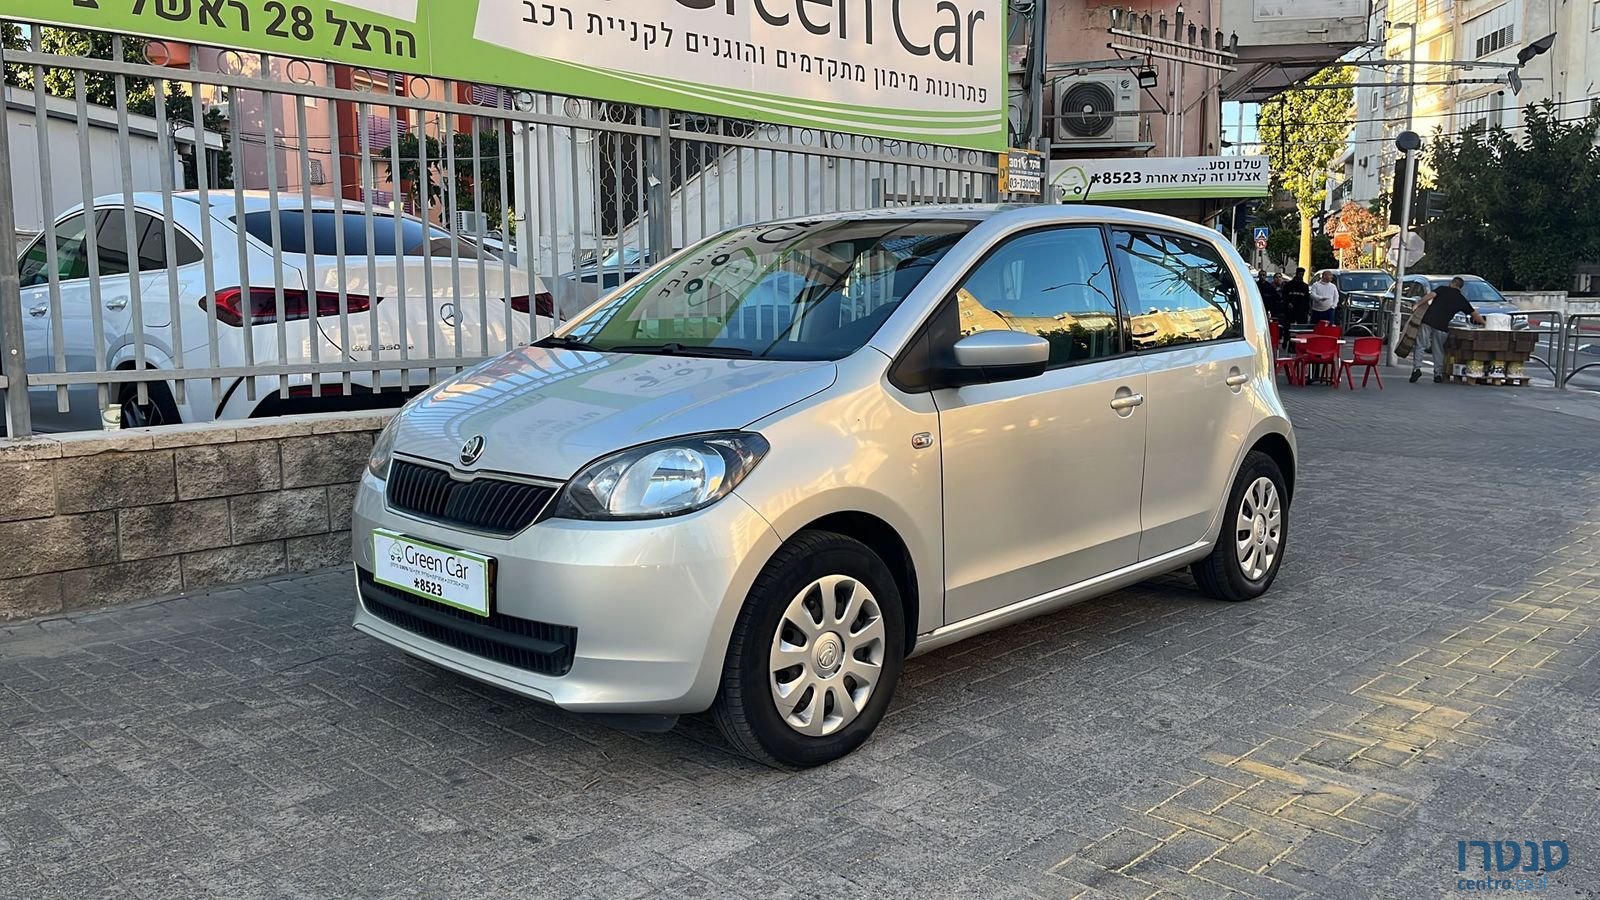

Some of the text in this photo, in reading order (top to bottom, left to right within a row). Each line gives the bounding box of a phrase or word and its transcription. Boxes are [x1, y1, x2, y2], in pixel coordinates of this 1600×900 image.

[264, 1, 315, 41] 28
[522, 0, 574, 30] רכב
[326, 9, 417, 59] הרצל
[587, 12, 673, 50] לקניית
[892, 0, 985, 65] Car
[685, 31, 765, 65] והוגנים
[776, 49, 865, 82] מתקדמים
[874, 68, 918, 92] מימון
[926, 77, 987, 103] פתרונות
[1146, 173, 1178, 183] אחרת
[1181, 173, 1206, 184] קצת
[1210, 172, 1224, 182] זה
[1228, 171, 1261, 182] אצלנו
[1234, 158, 1262, 170] שלם
[405, 545, 443, 573] Green
[446, 556, 469, 580] Car
